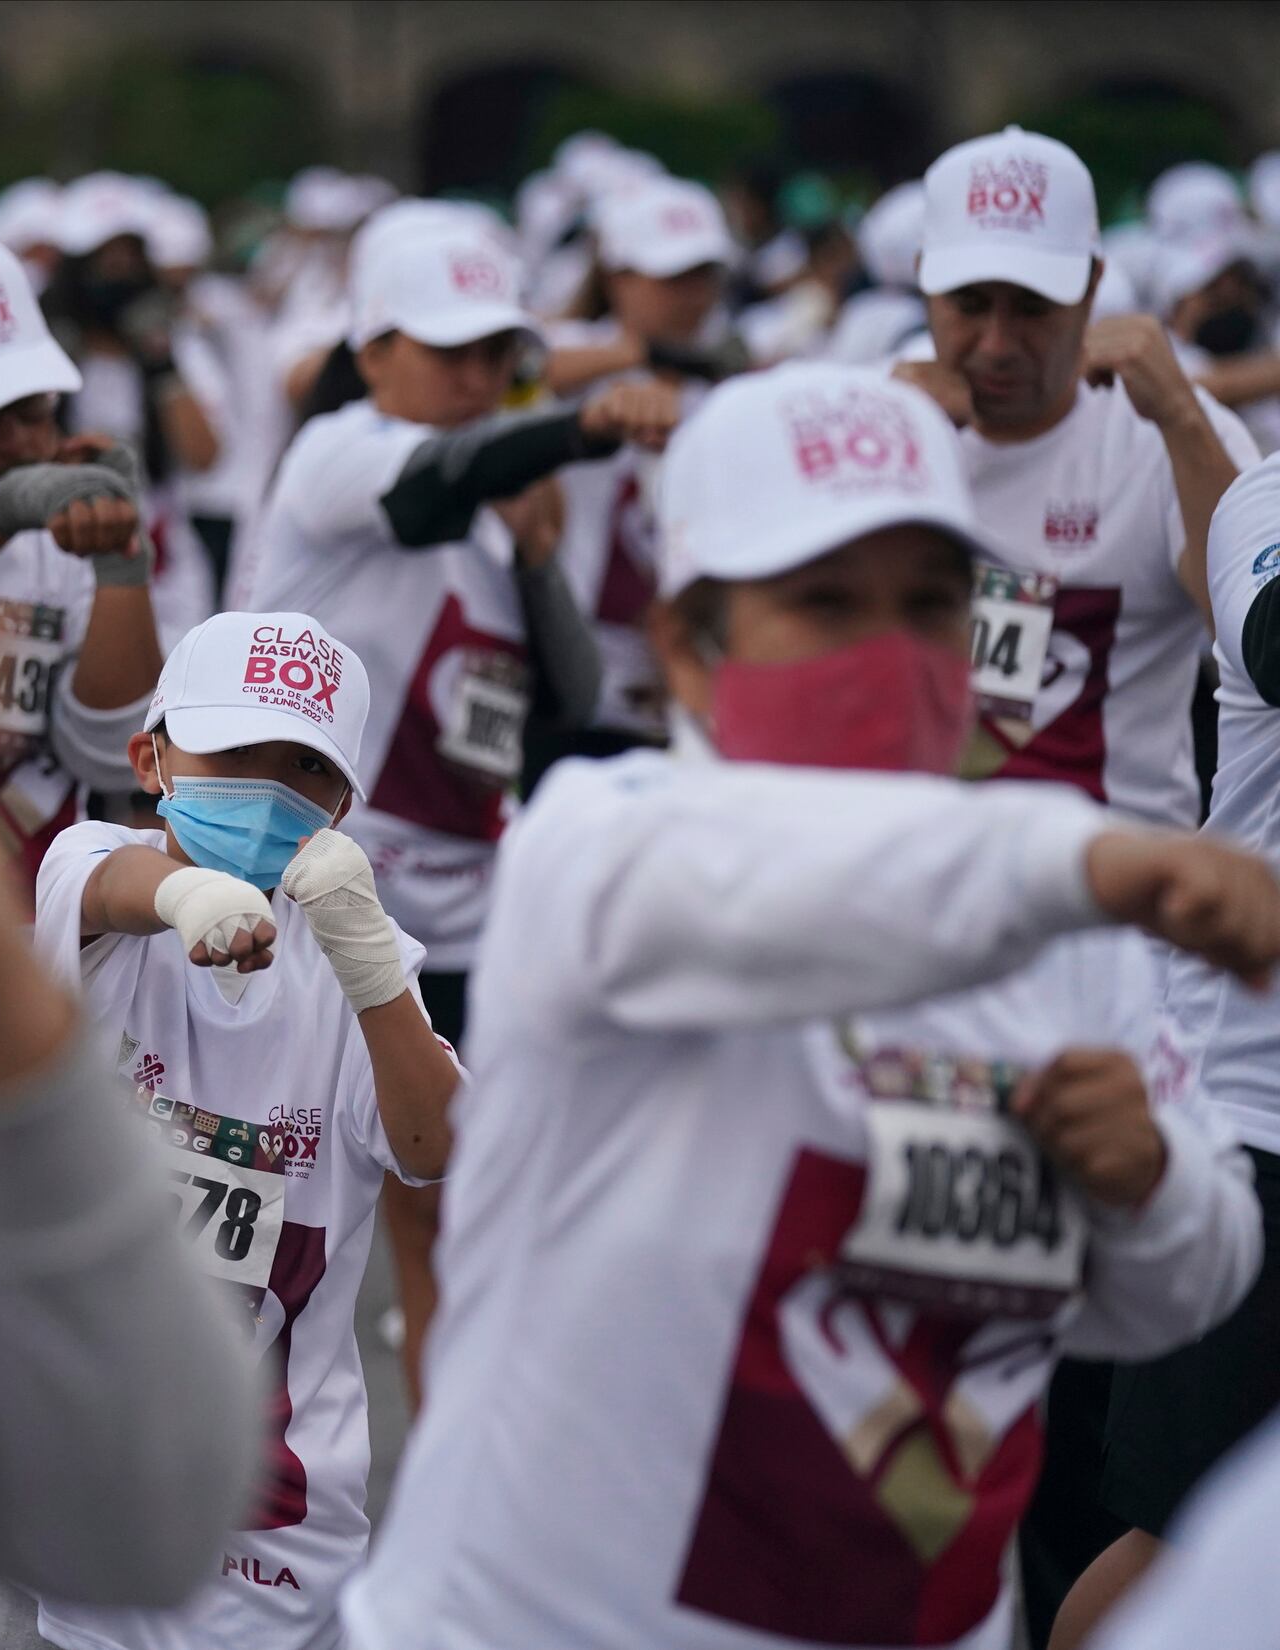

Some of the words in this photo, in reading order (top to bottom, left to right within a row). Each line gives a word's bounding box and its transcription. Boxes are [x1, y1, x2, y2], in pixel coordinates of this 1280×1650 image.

[968, 186, 1045, 219] BOX
[1045, 519, 1099, 543] BOX
[250, 644, 322, 669] MASIVA
[324, 663, 341, 685] DE
[253, 626, 343, 674] CLASE
[242, 685, 285, 696] CIUDAD
[287, 689, 302, 701] DE
[303, 697, 334, 724] MÉXICO
[244, 656, 339, 714] BOX
[258, 695, 269, 704] 18
[270, 697, 301, 711] JUNIO
[301, 705, 322, 724] 2022
[268, 1104, 322, 1125] CLASE
[305, 1126, 322, 1136] DE
[170, 1174, 262, 1262] 78
[221, 1551, 301, 1591] PILA
